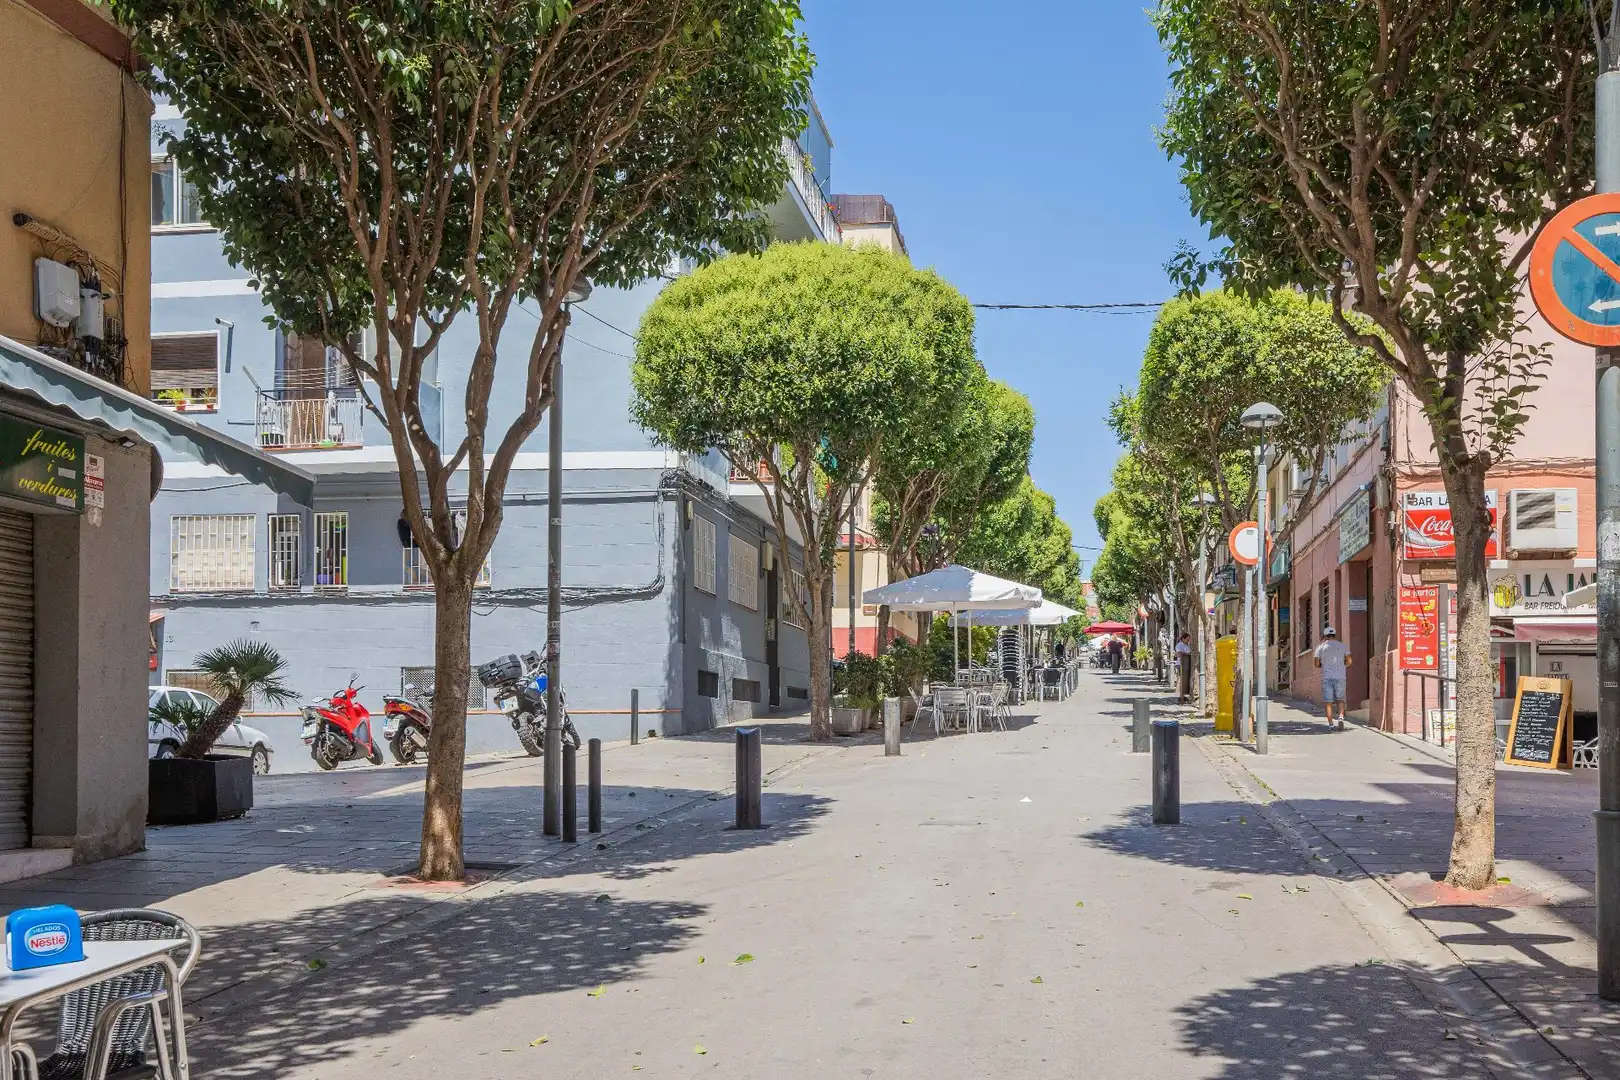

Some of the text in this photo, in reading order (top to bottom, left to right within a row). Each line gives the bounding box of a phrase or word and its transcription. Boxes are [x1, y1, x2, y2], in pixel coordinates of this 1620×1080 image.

[21, 429, 76, 461] fruites
[47, 460, 54, 473] i
[18, 477, 78, 501] verdures
[1524, 572, 1555, 597] LA
[1524, 601, 1539, 610] BAR
[33, 925, 61, 934] HELADOS
[30, 935, 65, 949] Nestlé
